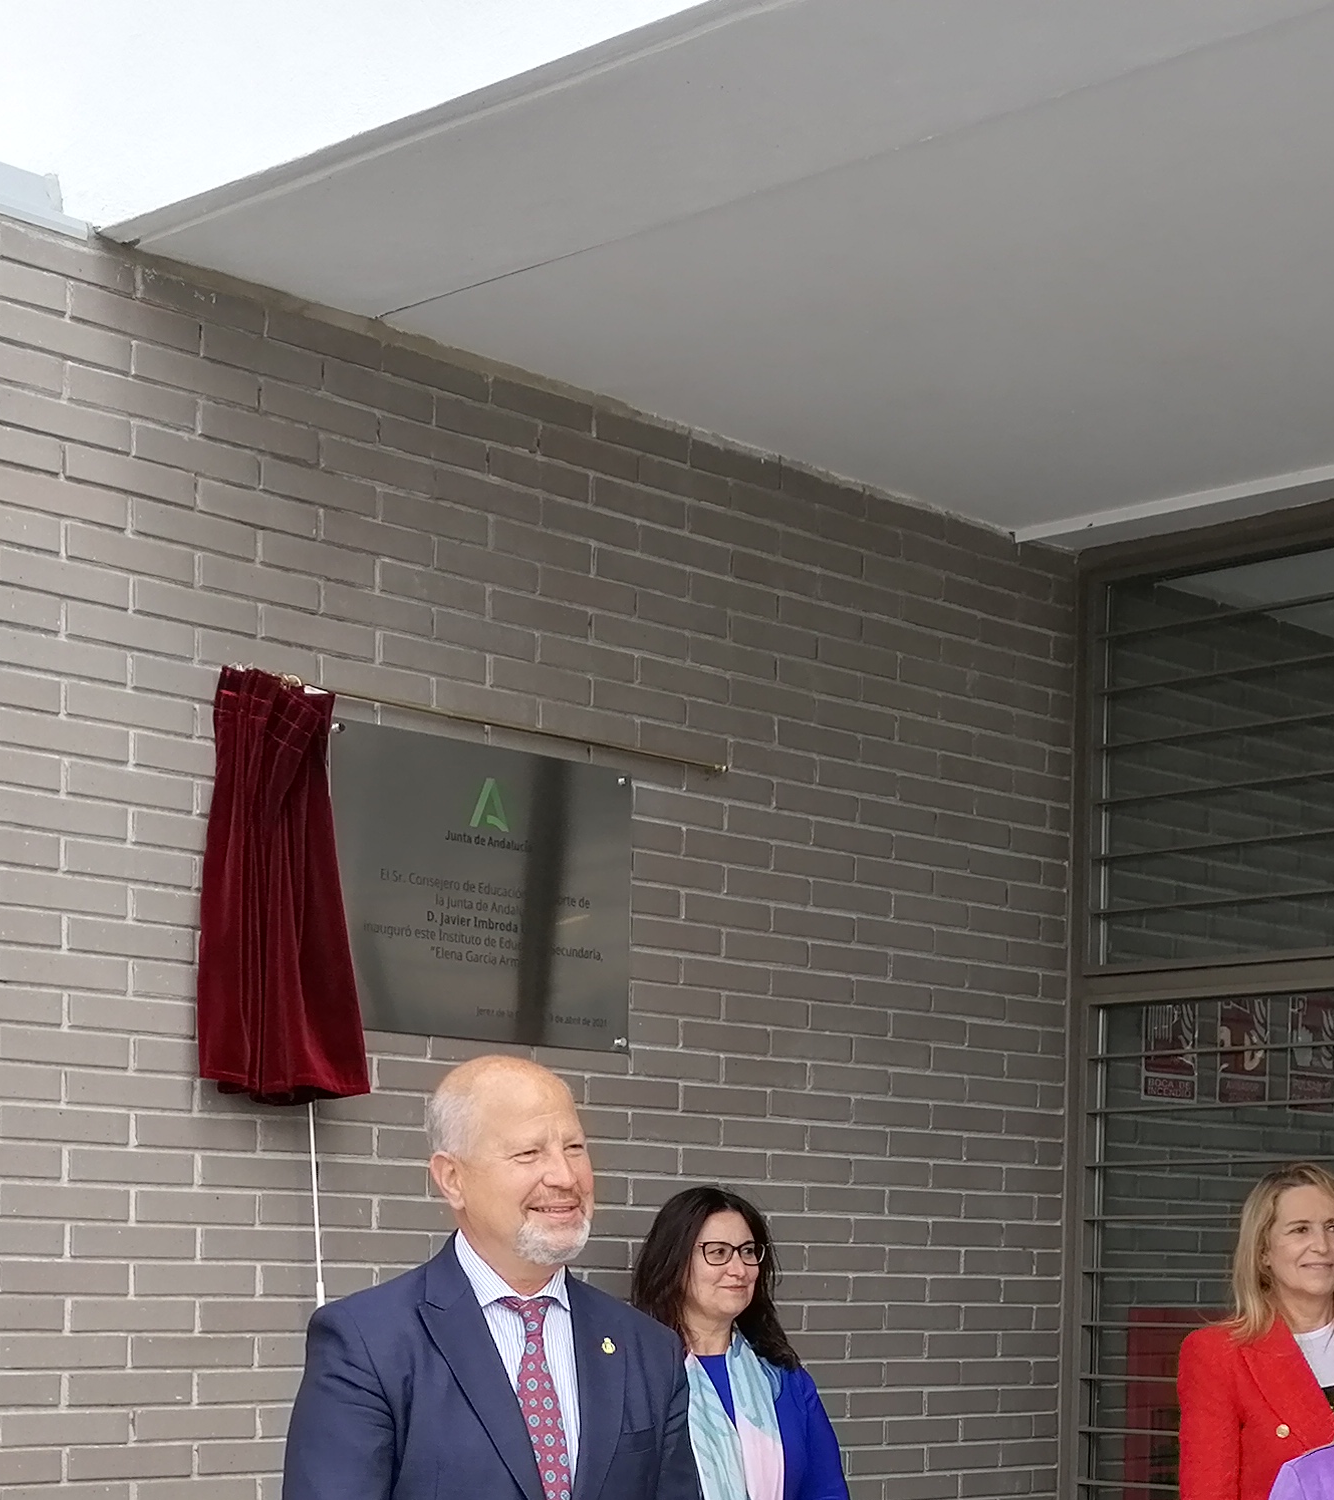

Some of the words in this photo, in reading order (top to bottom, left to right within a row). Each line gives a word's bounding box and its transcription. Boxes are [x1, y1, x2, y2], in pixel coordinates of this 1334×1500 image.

[445, 830, 472, 844] Junta
[474, 835, 486, 846] de
[380, 868, 389, 881] El
[392, 870, 406, 883] Sr.
[409, 872, 461, 891] Consejero
[463, 880, 475, 893] de
[578, 897, 590, 909] de
[435, 893, 444, 906] la
[446, 896, 473, 910] Junta
[476, 899, 488, 912] de
[427, 910, 438, 923] D.
[439, 912, 471, 927] Javier
[474, 916, 518, 934] Imbroda
[363, 921, 412, 938] inauguró
[414, 928, 436, 940] este
[439, 929, 482, 946] Instituto
[484, 935, 497, 948] de
[582, 1017, 591, 1026] de
[1147, 1087, 1191, 1098] INCENDIO
[1148, 1078, 1174, 1088] BOCA
[1179, 1080, 1191, 1090] DE
